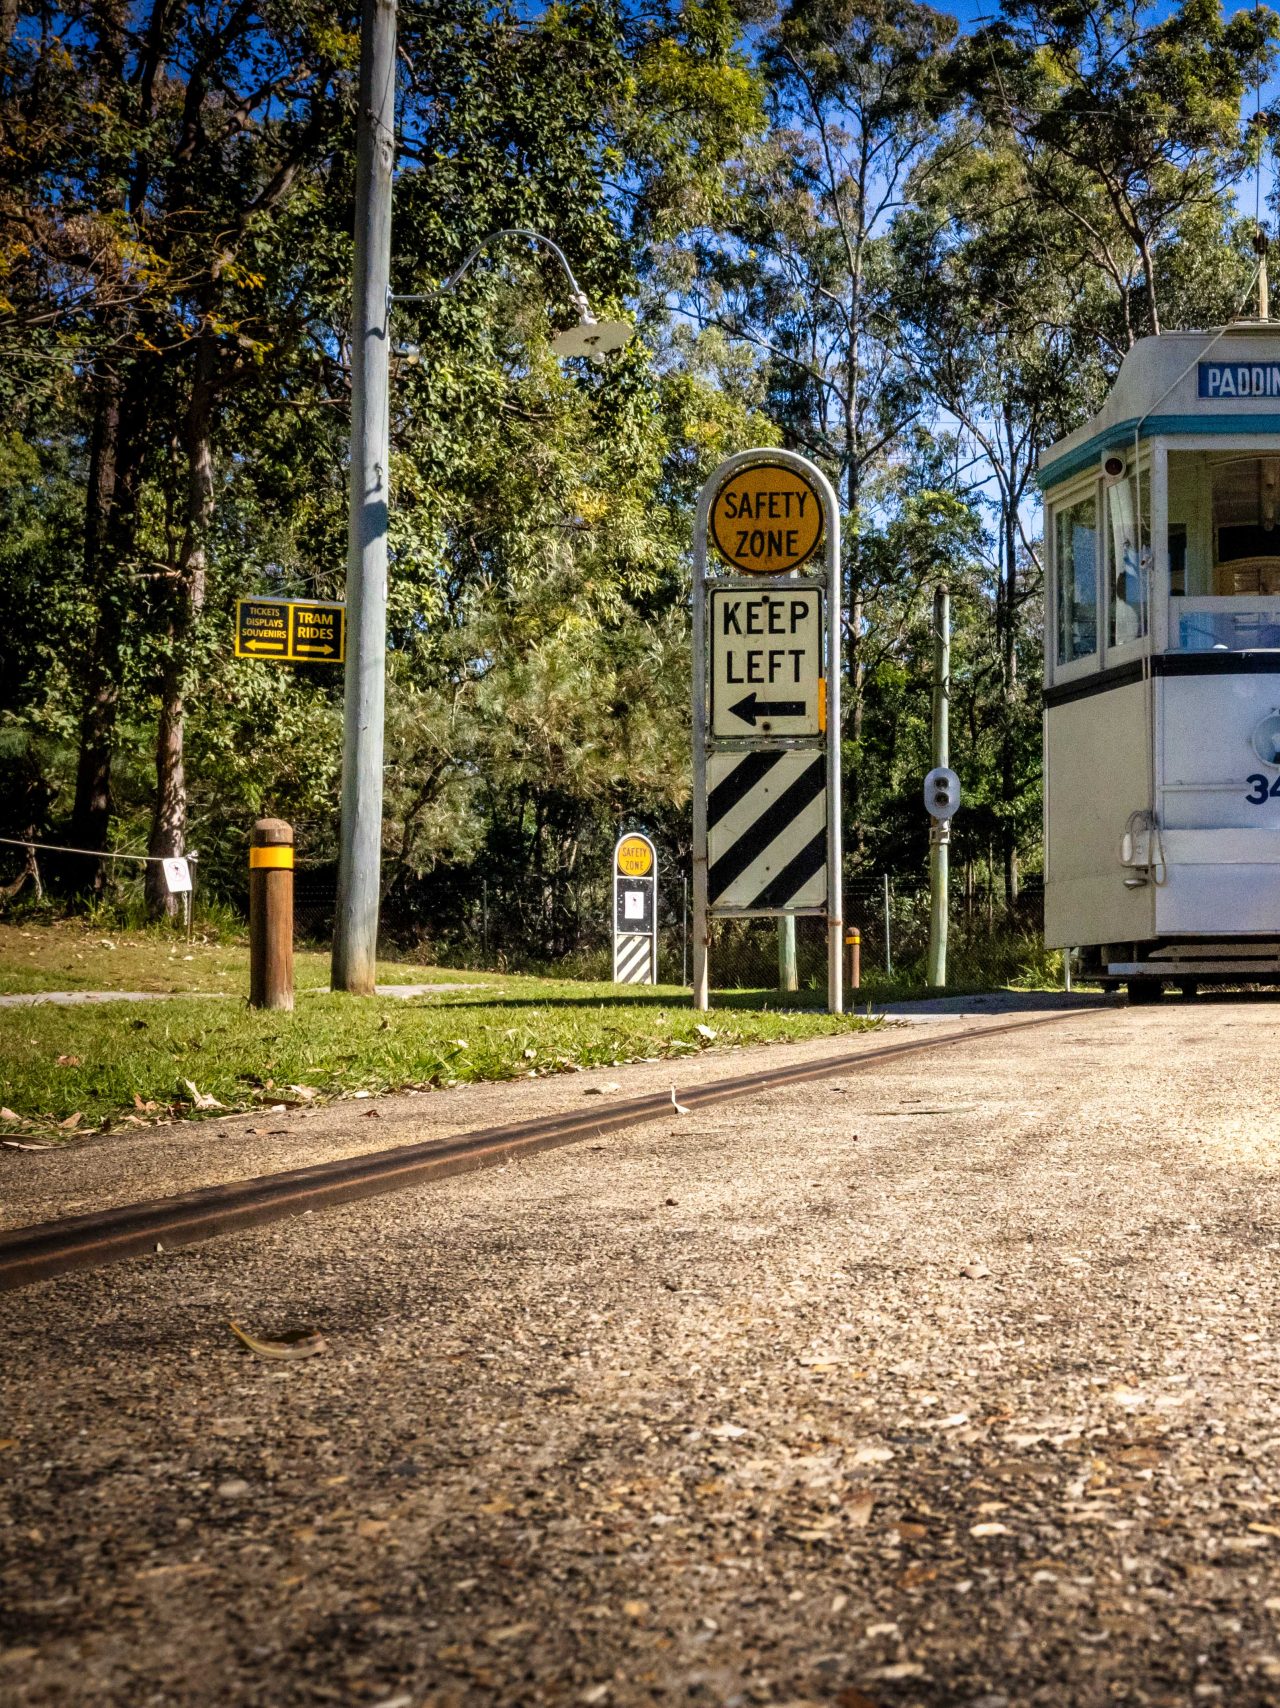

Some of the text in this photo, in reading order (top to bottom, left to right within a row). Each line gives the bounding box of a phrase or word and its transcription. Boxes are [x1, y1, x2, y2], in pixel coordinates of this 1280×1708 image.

[724, 491, 808, 519] SAFETY
[735, 530, 799, 557] ZONE
[249, 607, 280, 617] TICKETS
[297, 611, 334, 625] TRAM
[723, 601, 809, 635] KEEP
[246, 617, 284, 628] DISPLAYS
[242, 628, 287, 639] SOUVENIRS
[297, 626, 334, 640] RIDES
[726, 650, 806, 683] LEFT
[622, 847, 647, 857] SAFETY
[625, 860, 644, 871] ZONE
